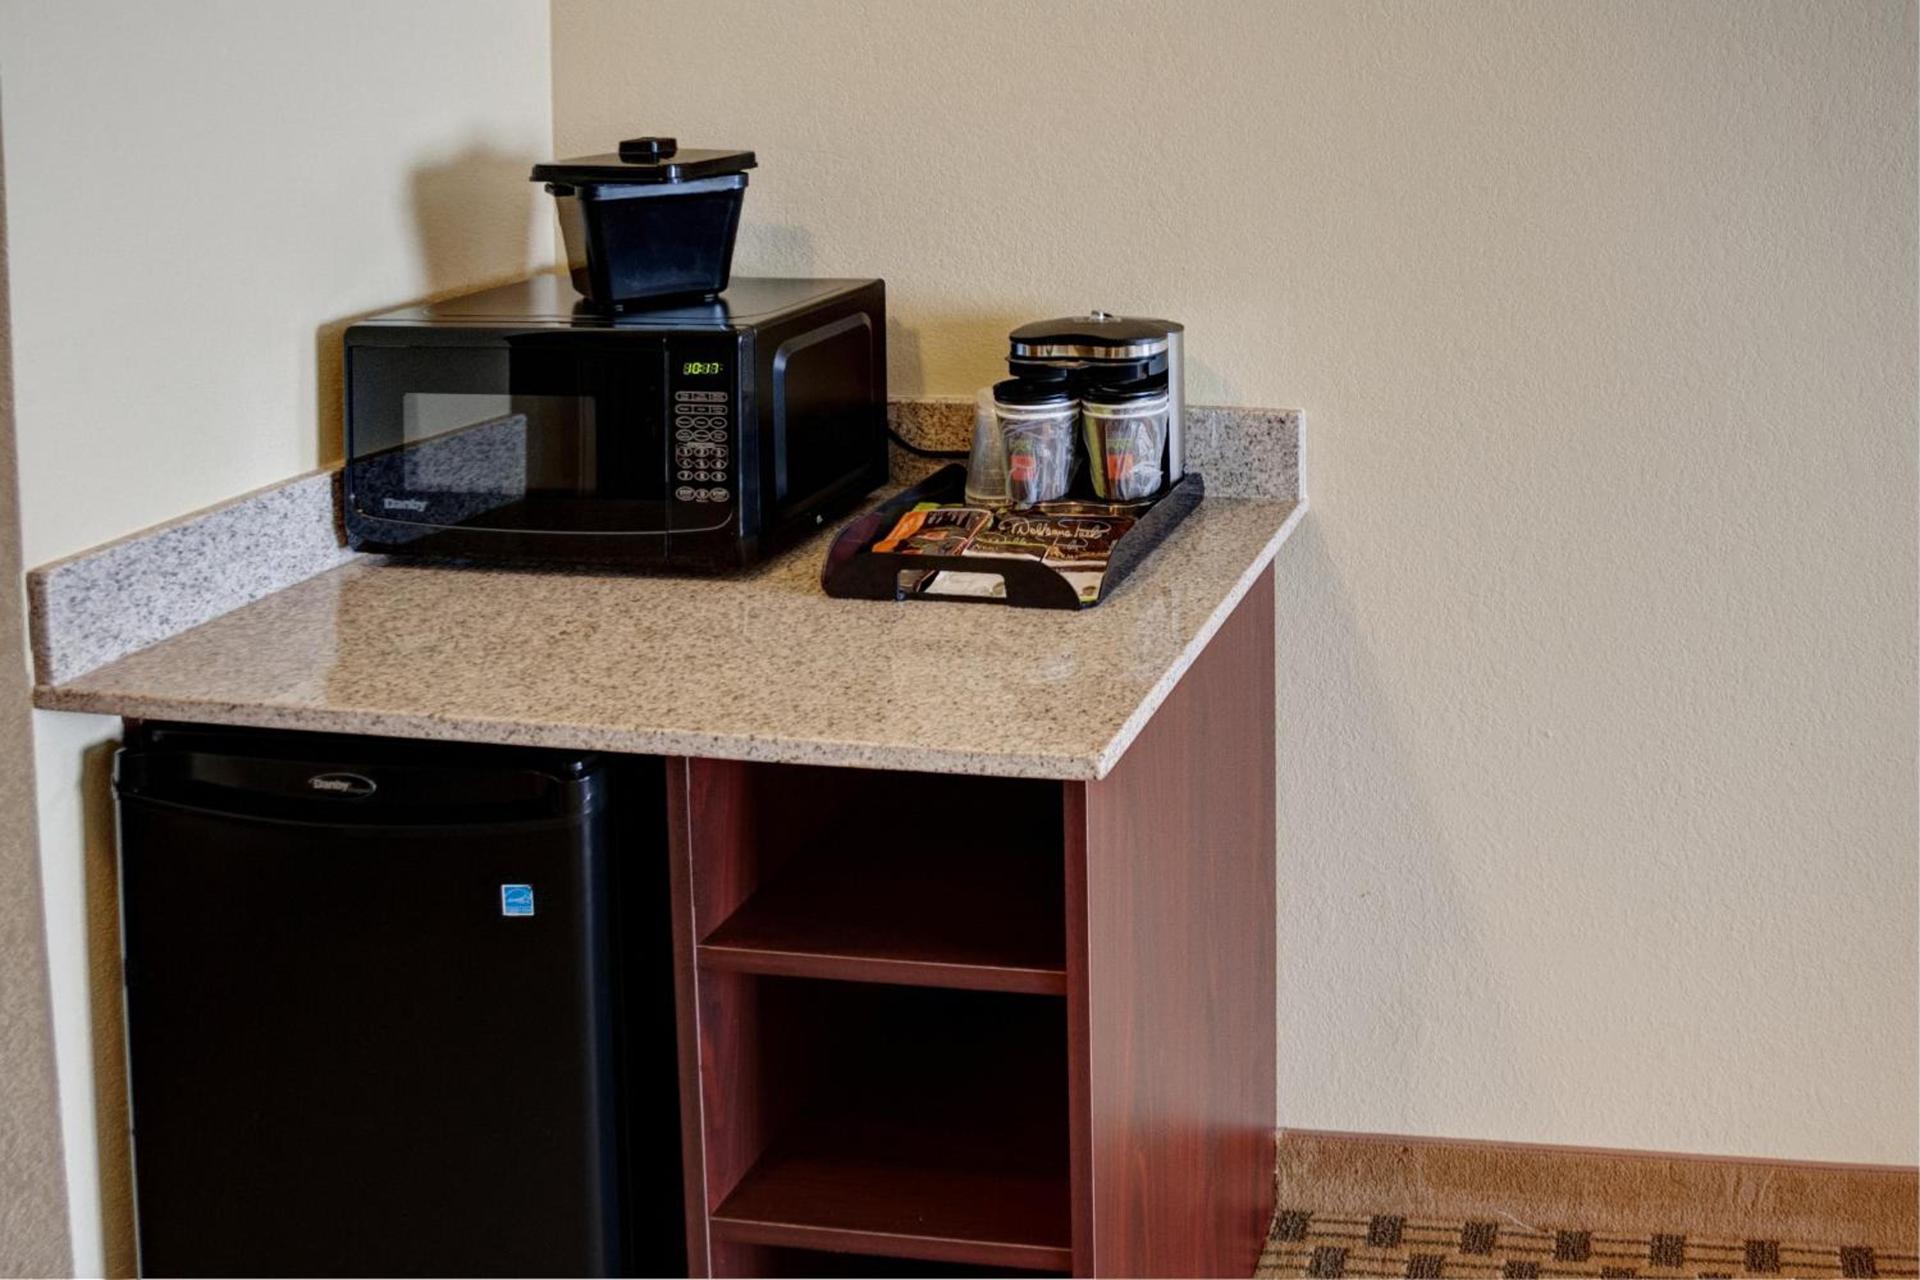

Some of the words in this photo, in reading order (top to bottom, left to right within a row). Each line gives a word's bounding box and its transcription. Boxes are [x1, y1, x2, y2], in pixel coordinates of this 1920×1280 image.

[687, 362, 720, 375] 10:17
[384, 498, 428, 512] Danby
[313, 779, 350, 793] Danby
